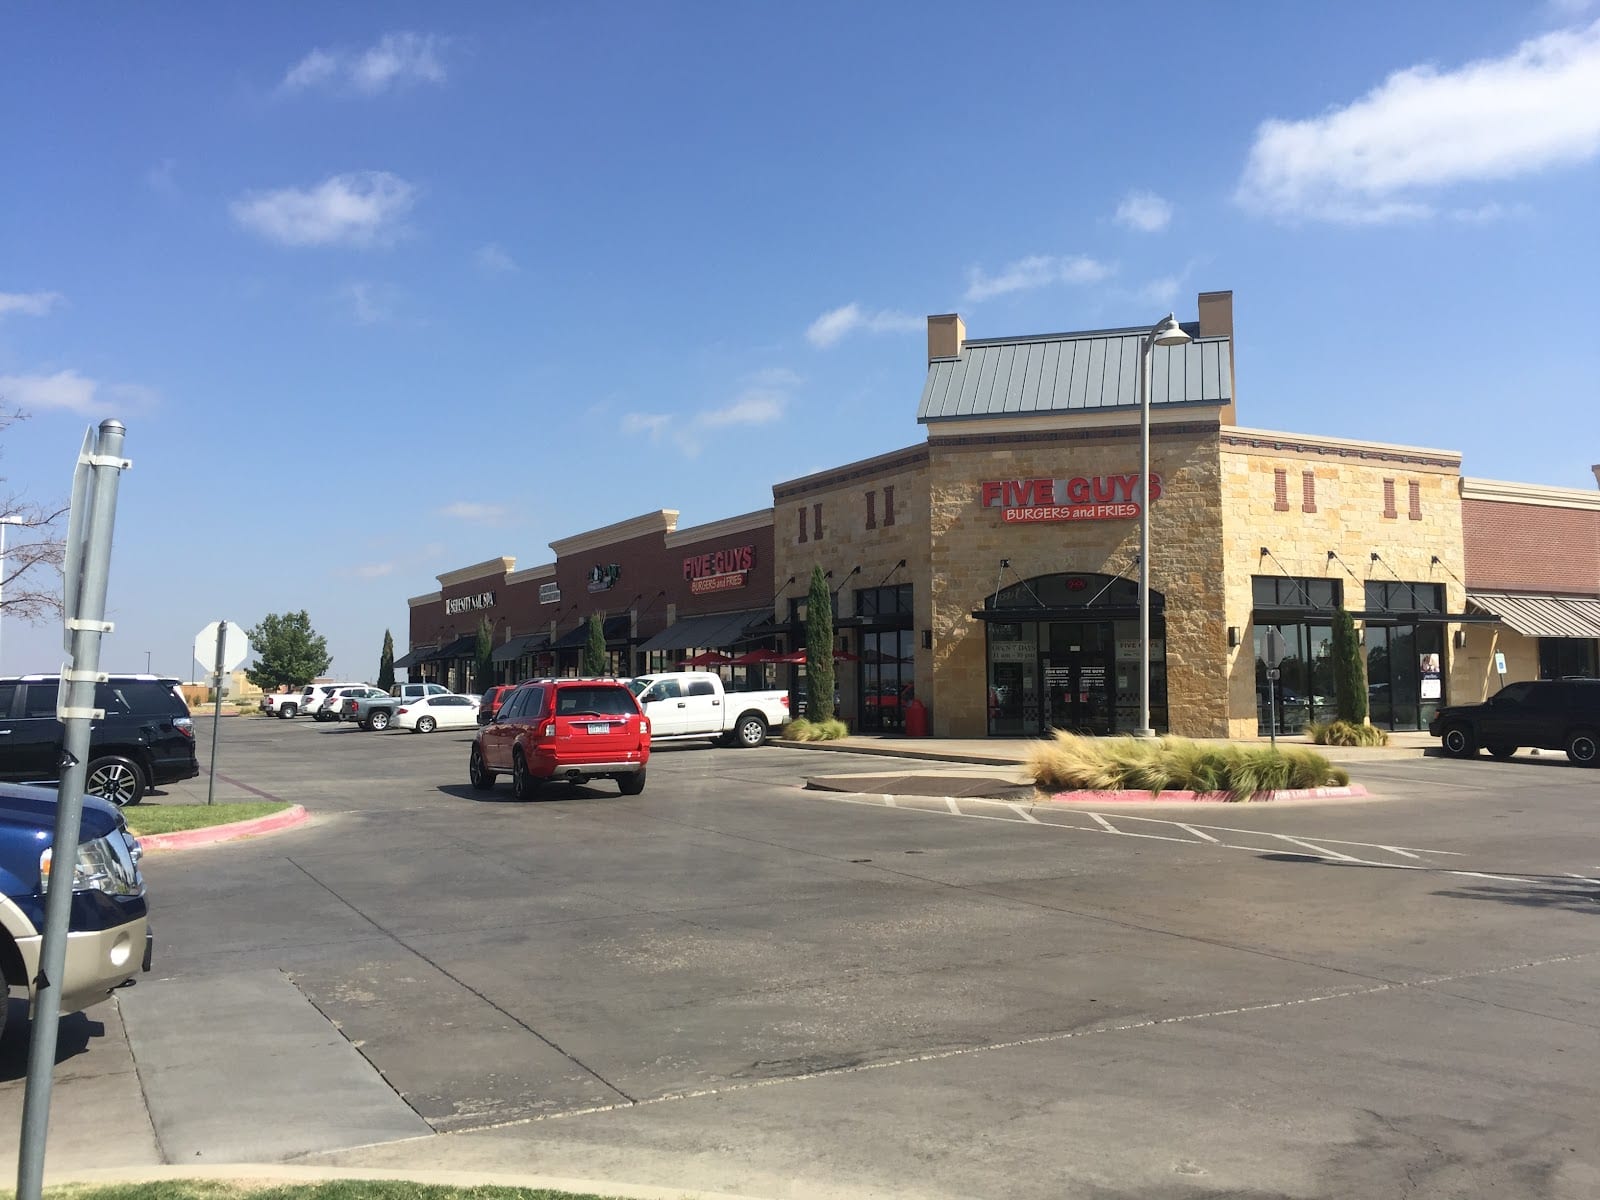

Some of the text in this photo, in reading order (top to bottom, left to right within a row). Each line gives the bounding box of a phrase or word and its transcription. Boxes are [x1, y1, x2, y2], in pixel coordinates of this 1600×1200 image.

[981, 472, 1162, 507] FIVE GUYS
[1006, 504, 1137, 520] BURGERS and FRIES
[683, 545, 753, 578] FIVE GUYS
[691, 574, 743, 592] BURGERS and FRIES
